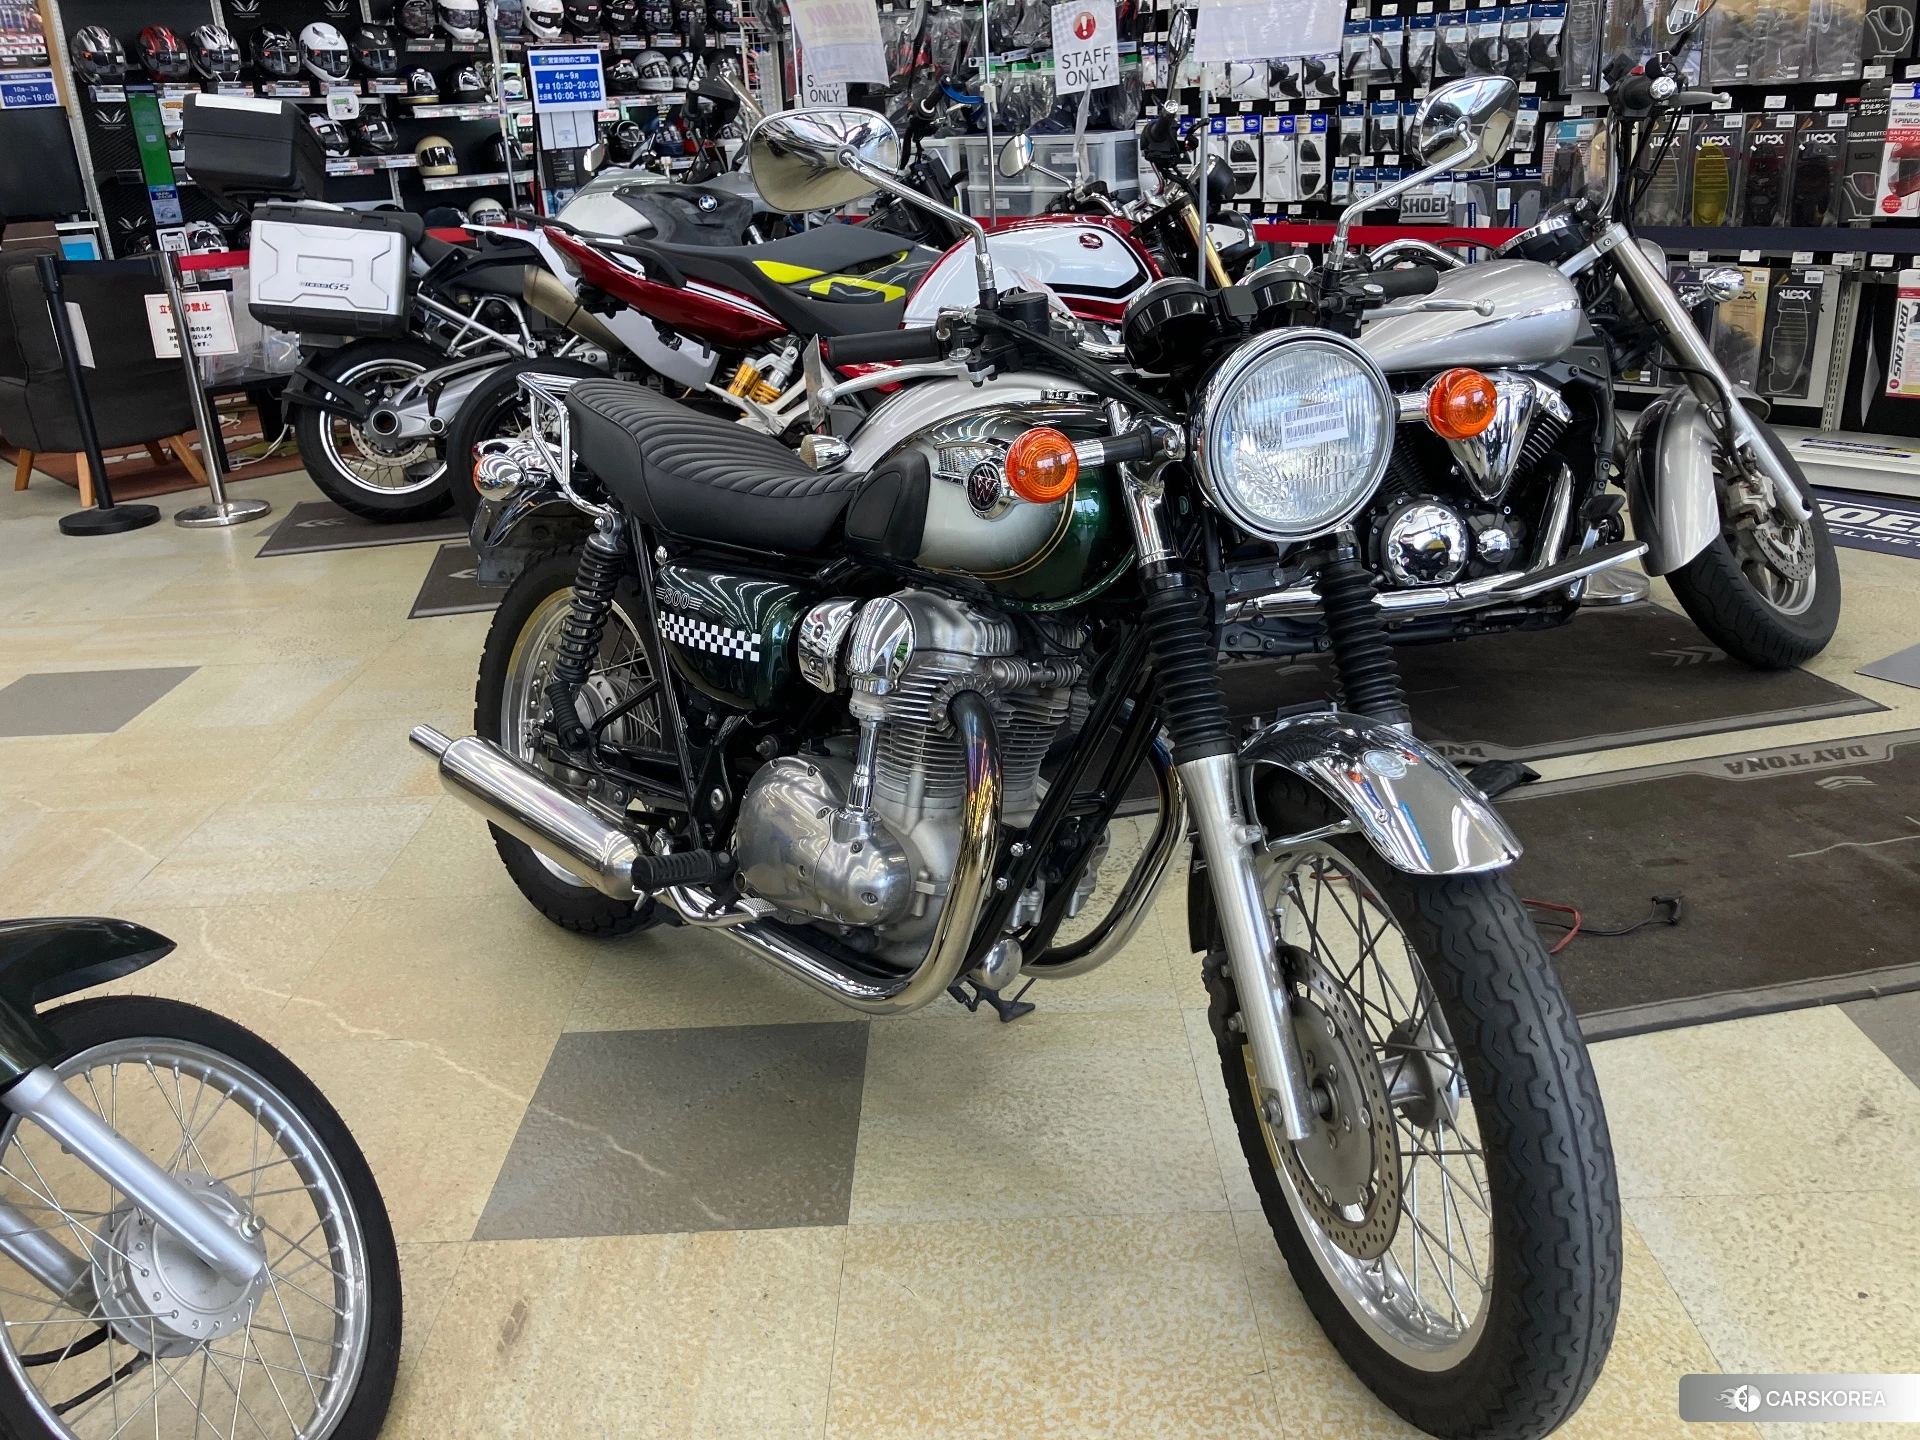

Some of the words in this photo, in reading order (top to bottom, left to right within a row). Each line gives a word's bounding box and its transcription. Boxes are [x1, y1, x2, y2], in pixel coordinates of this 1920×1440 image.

[1062, 46, 1111, 69] STAFF
[1066, 65, 1108, 86] ONLY
[810, 89, 840, 103] ONLY
[1401, 197, 1436, 213] SHOEI
[159, 302, 212, 314] 立り禁止
[1893, 303, 1910, 380] DRYLENS
[972, 473, 999, 502] W
[664, 588, 690, 609] 800
[1723, 744, 1871, 775] DAYTONA
